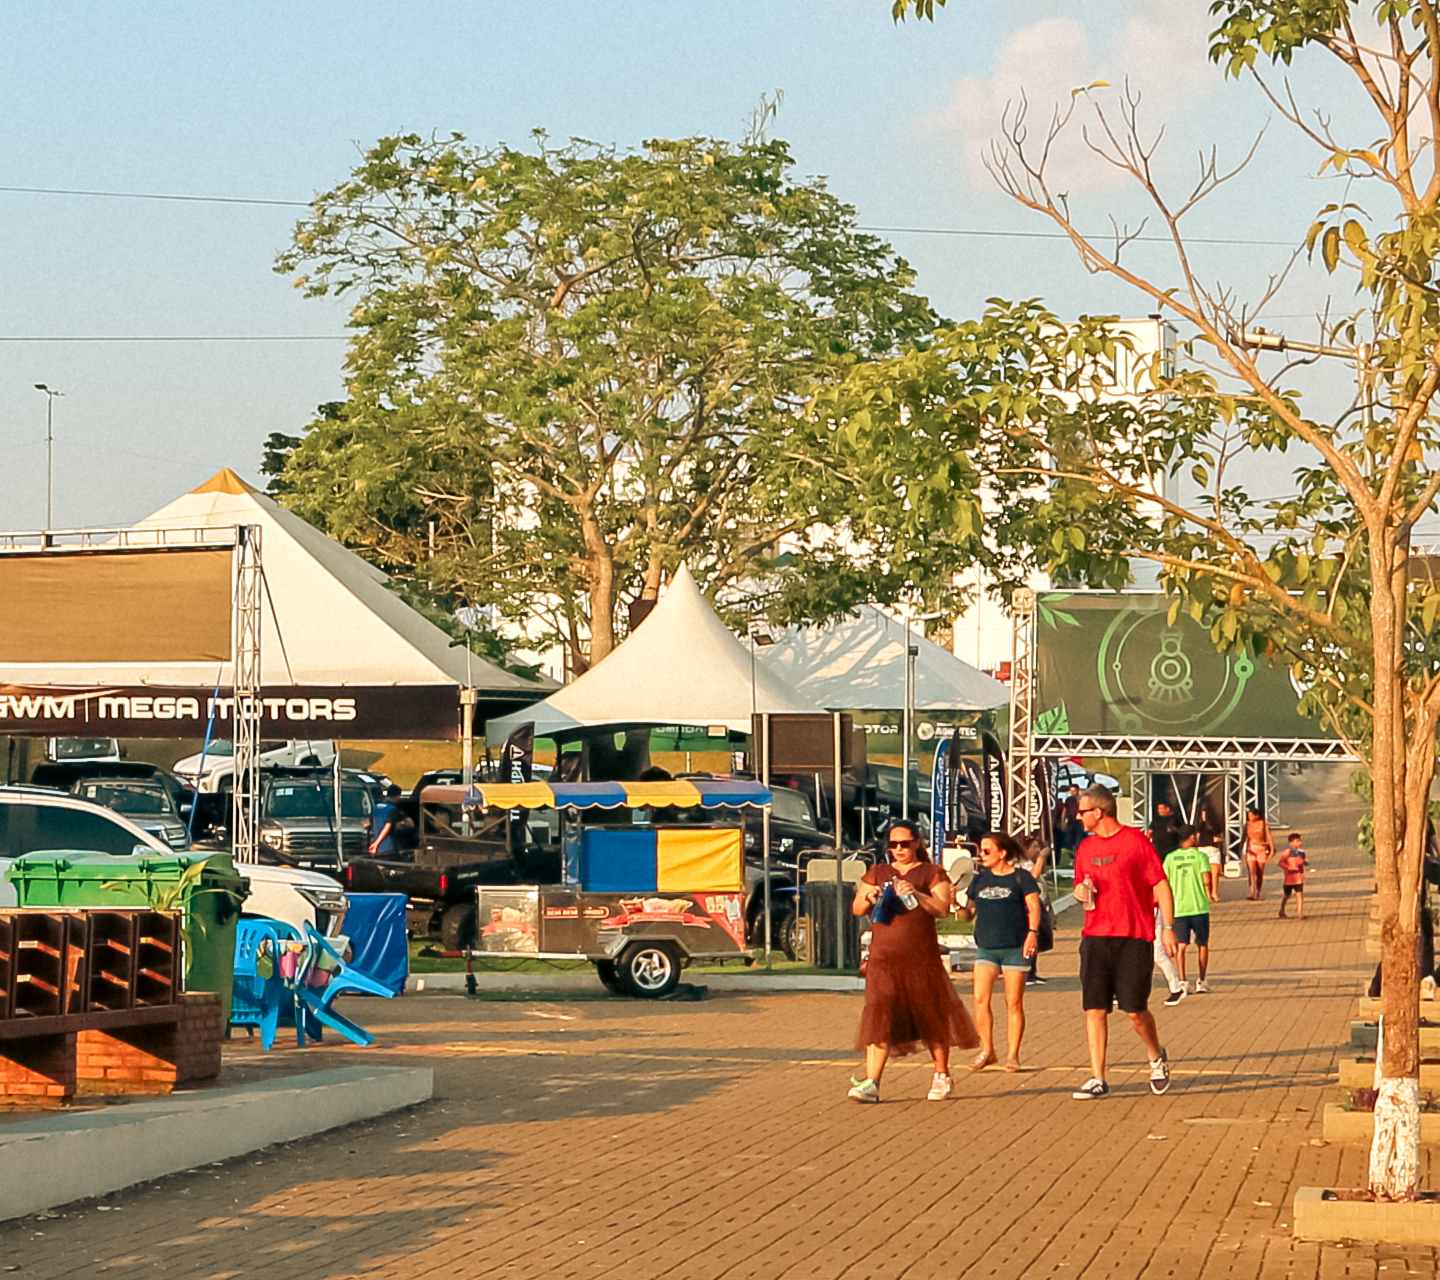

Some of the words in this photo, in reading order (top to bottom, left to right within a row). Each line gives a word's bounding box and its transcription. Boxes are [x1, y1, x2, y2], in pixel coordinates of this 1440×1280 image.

[98, 697, 199, 720] MEGA
[208, 697, 357, 720] MOTORS
[864, 724, 898, 734] OTOR
[990, 771, 1003, 833] TRIUMPH
